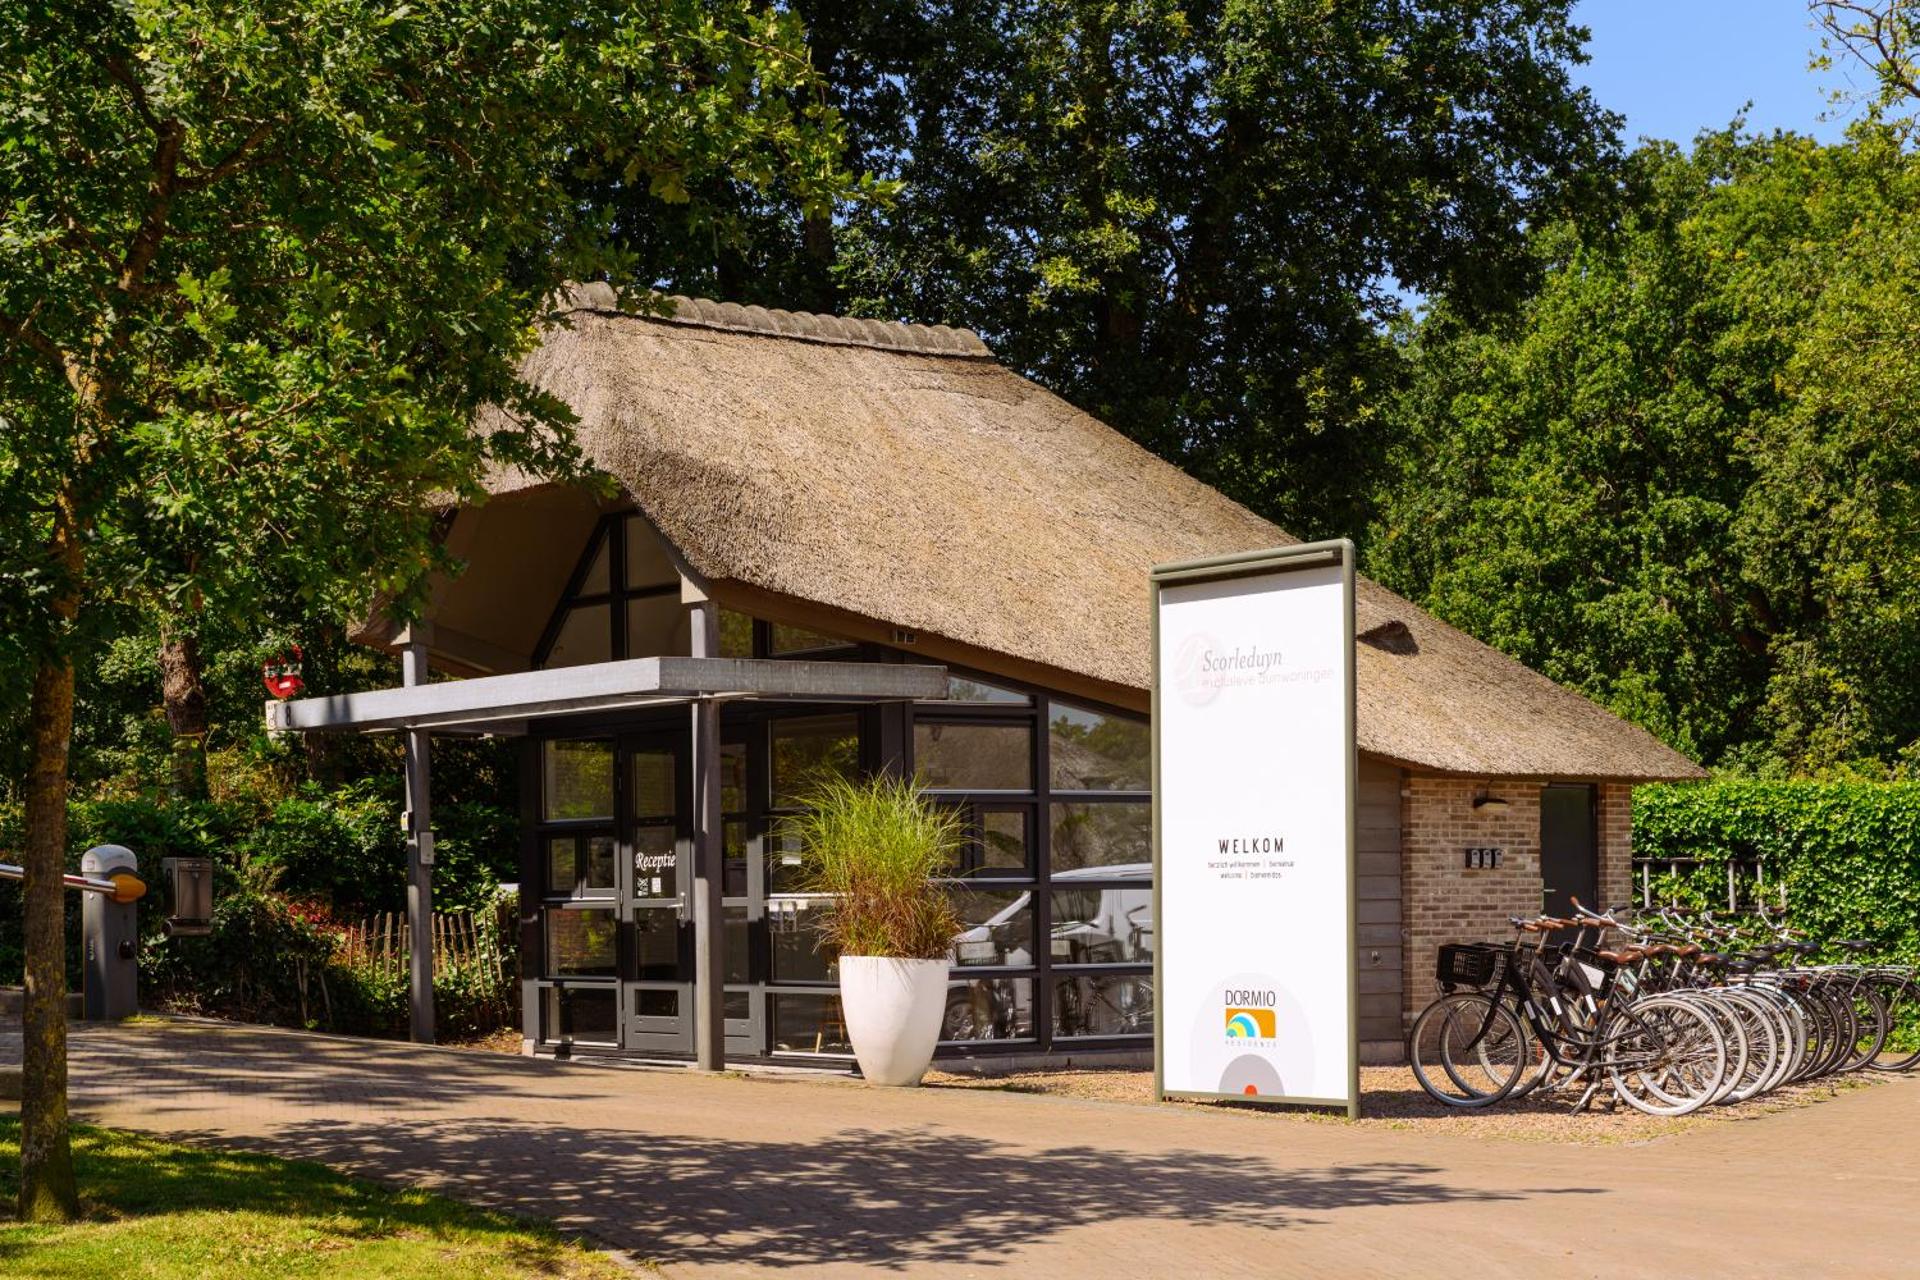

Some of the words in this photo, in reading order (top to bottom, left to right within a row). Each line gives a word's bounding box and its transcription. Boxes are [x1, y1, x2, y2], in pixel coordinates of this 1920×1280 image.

[1203, 645, 1283, 675] Scorleduyn
[1218, 837, 1284, 854] WELKOM
[635, 850, 677, 873] Receptie
[1225, 990, 1276, 1007] DORMIO
